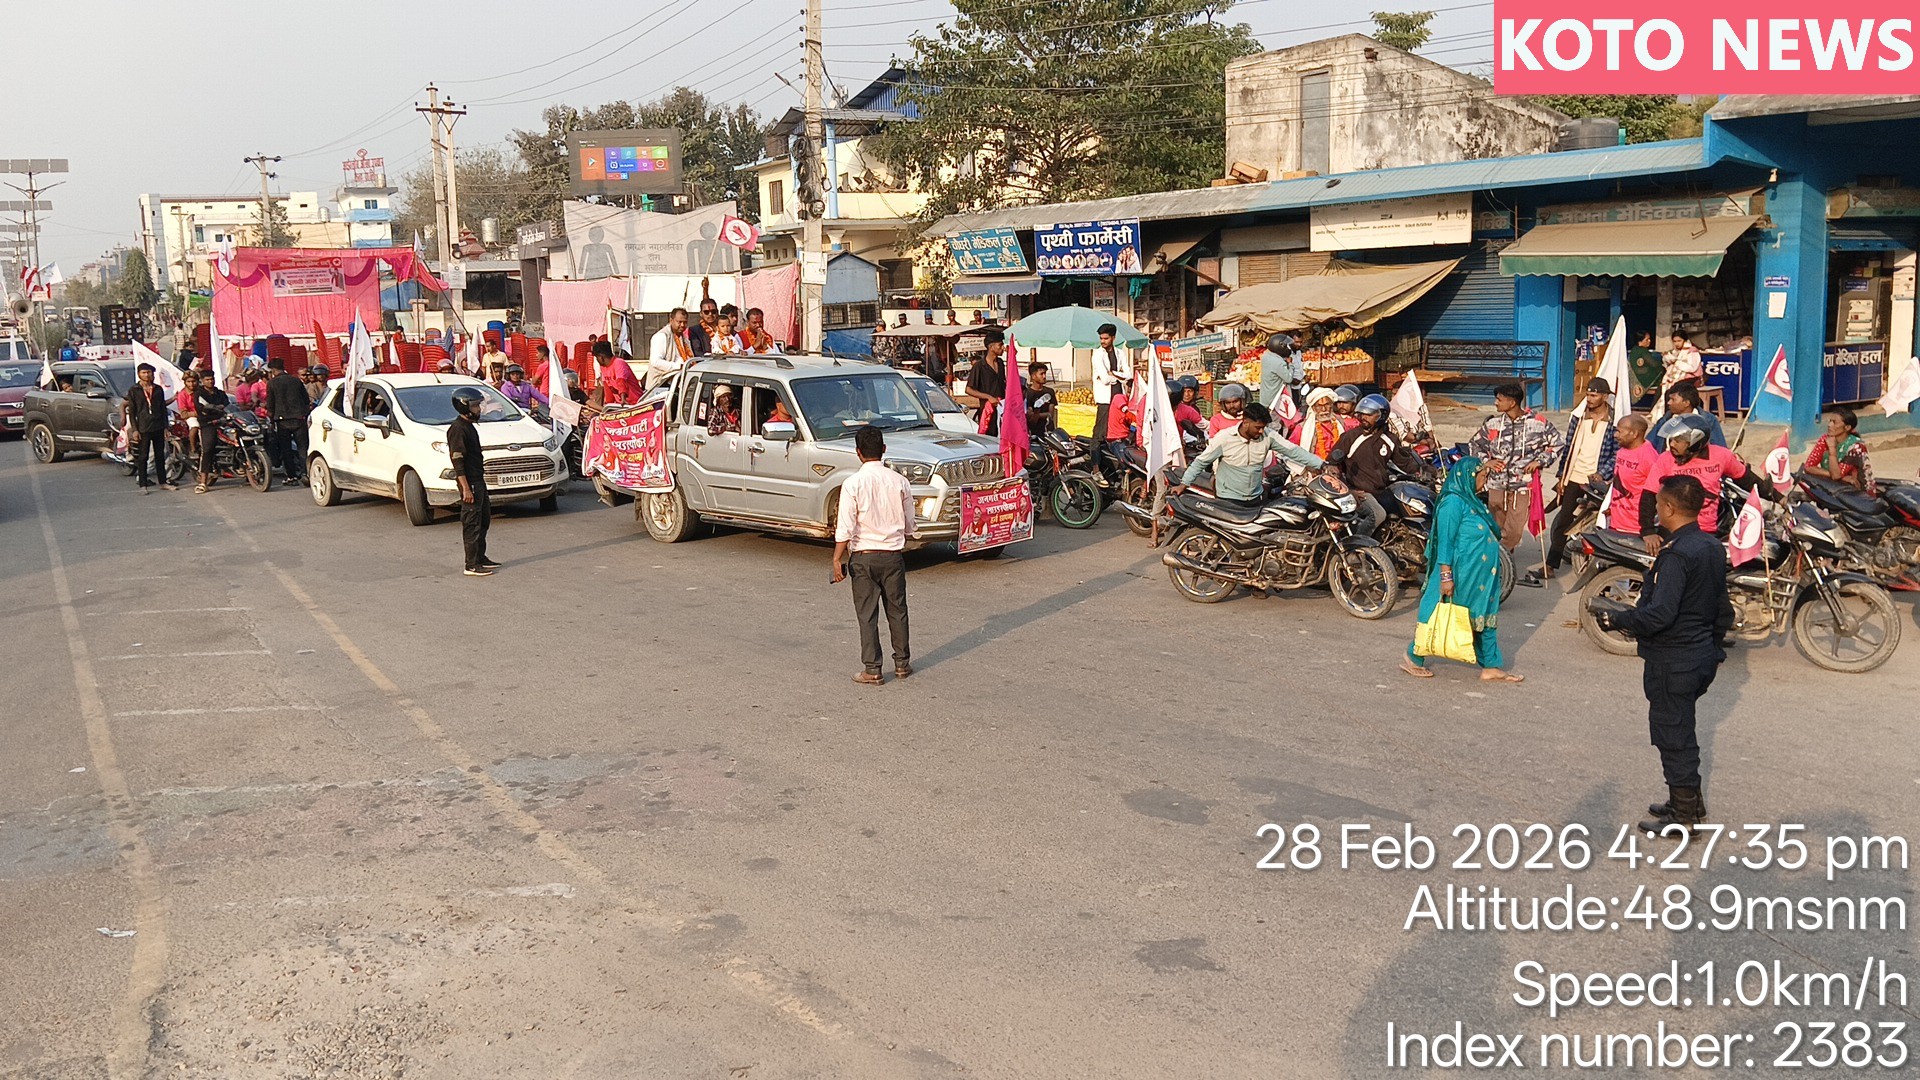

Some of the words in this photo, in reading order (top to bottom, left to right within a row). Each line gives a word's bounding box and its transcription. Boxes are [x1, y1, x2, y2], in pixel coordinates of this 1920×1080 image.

[972, 235, 1001, 249] मेडिकल
[1001, 235, 1016, 248] हल
[1040, 229, 1074, 252] पृथ्वी
[1835, 348, 1859, 366] मेडिकल
[1860, 350, 1883, 365] हल
[1705, 361, 1740, 376] हल
